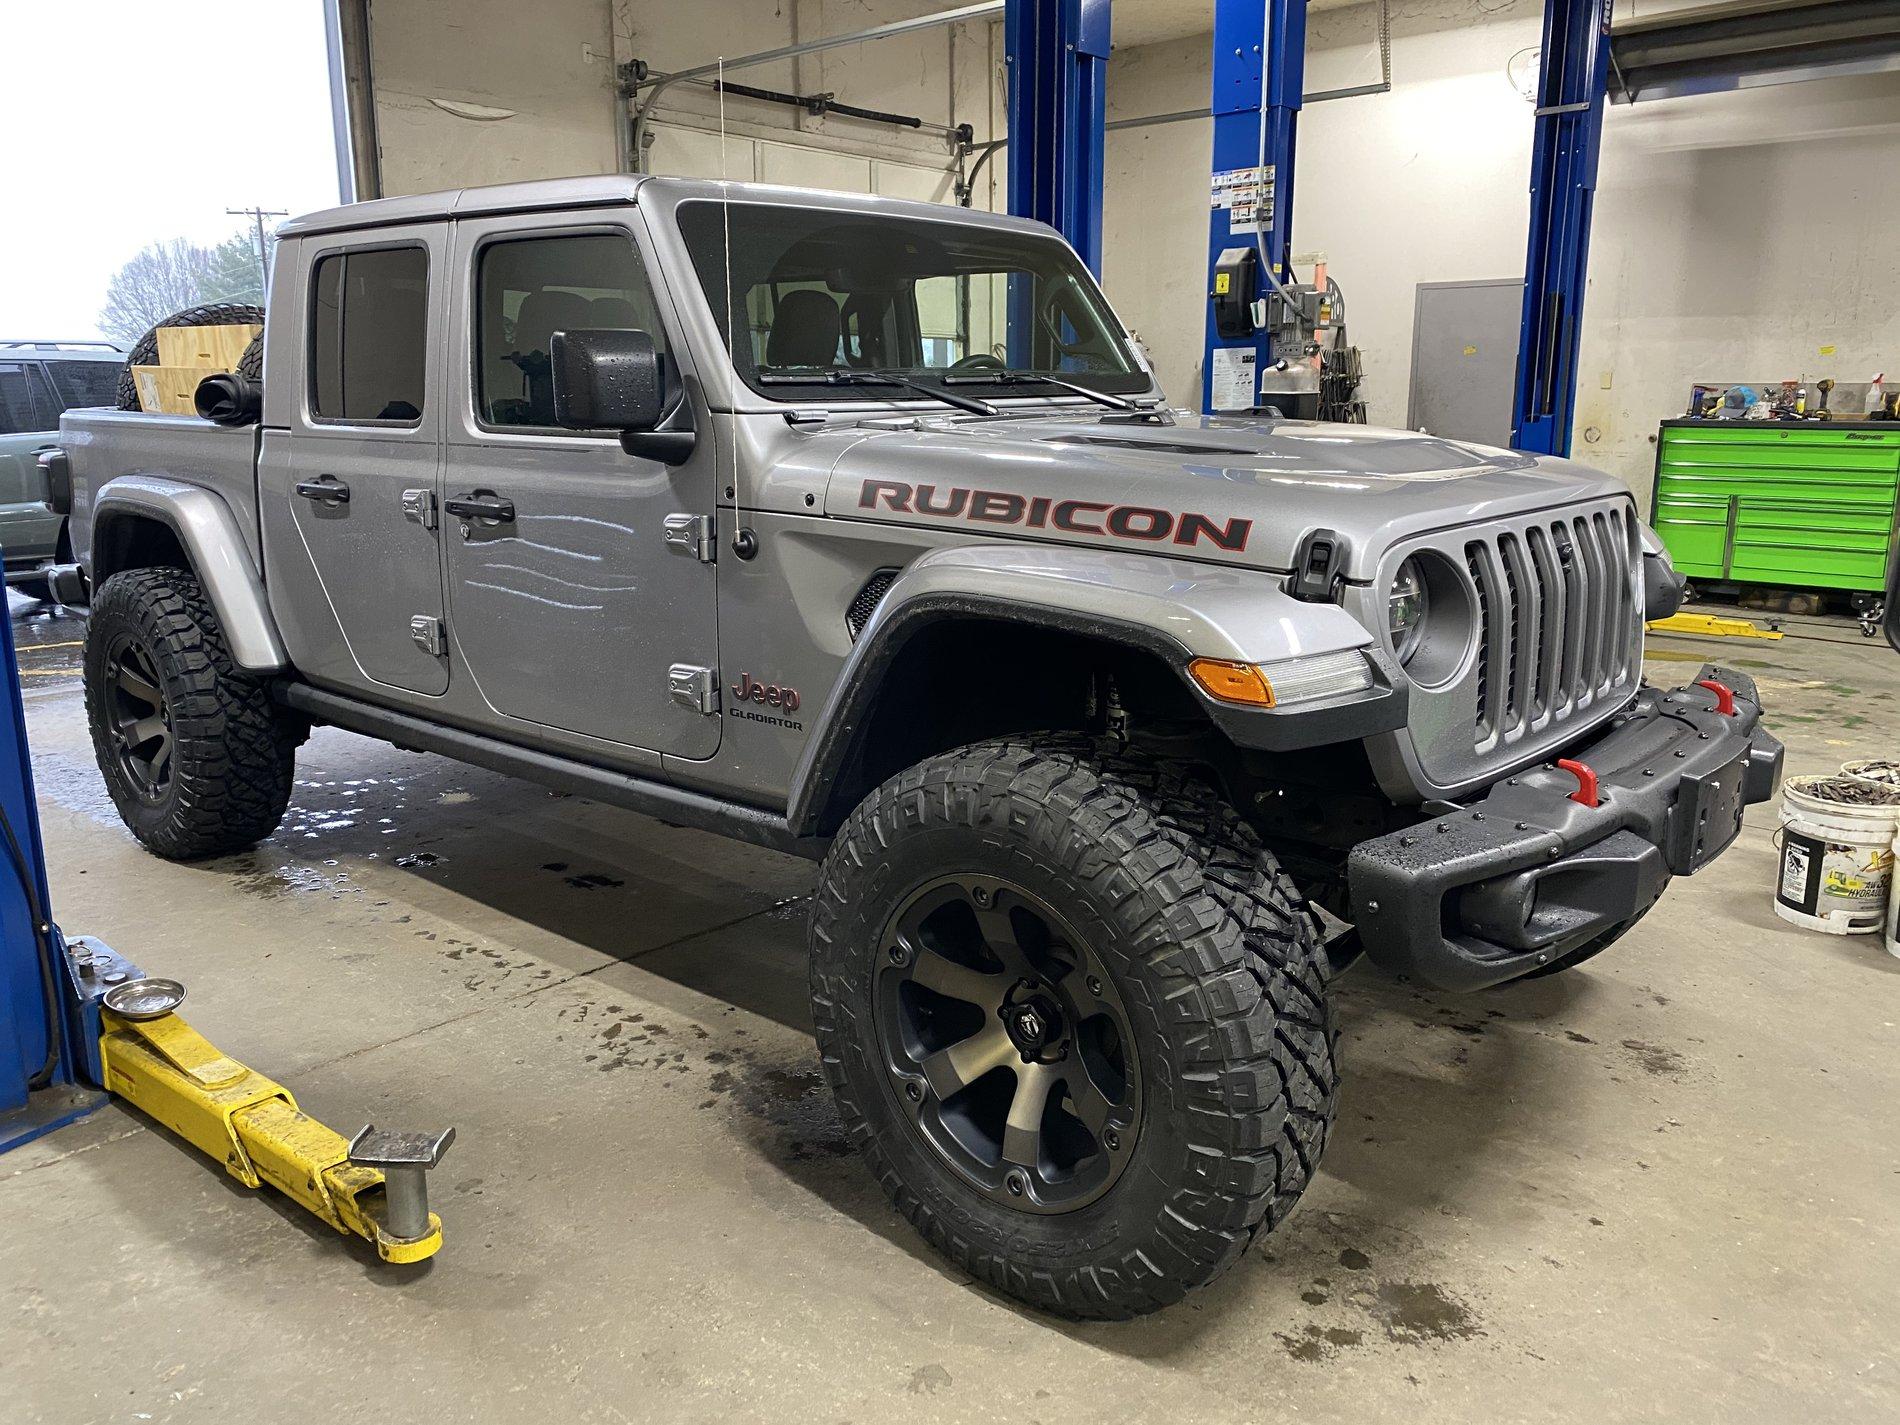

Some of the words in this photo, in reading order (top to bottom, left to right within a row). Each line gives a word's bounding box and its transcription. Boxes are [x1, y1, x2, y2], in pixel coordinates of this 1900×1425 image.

[858, 479, 1253, 552] RUBICON
[732, 672, 800, 716] Jeep
[730, 708, 803, 732] GLADIATOR
